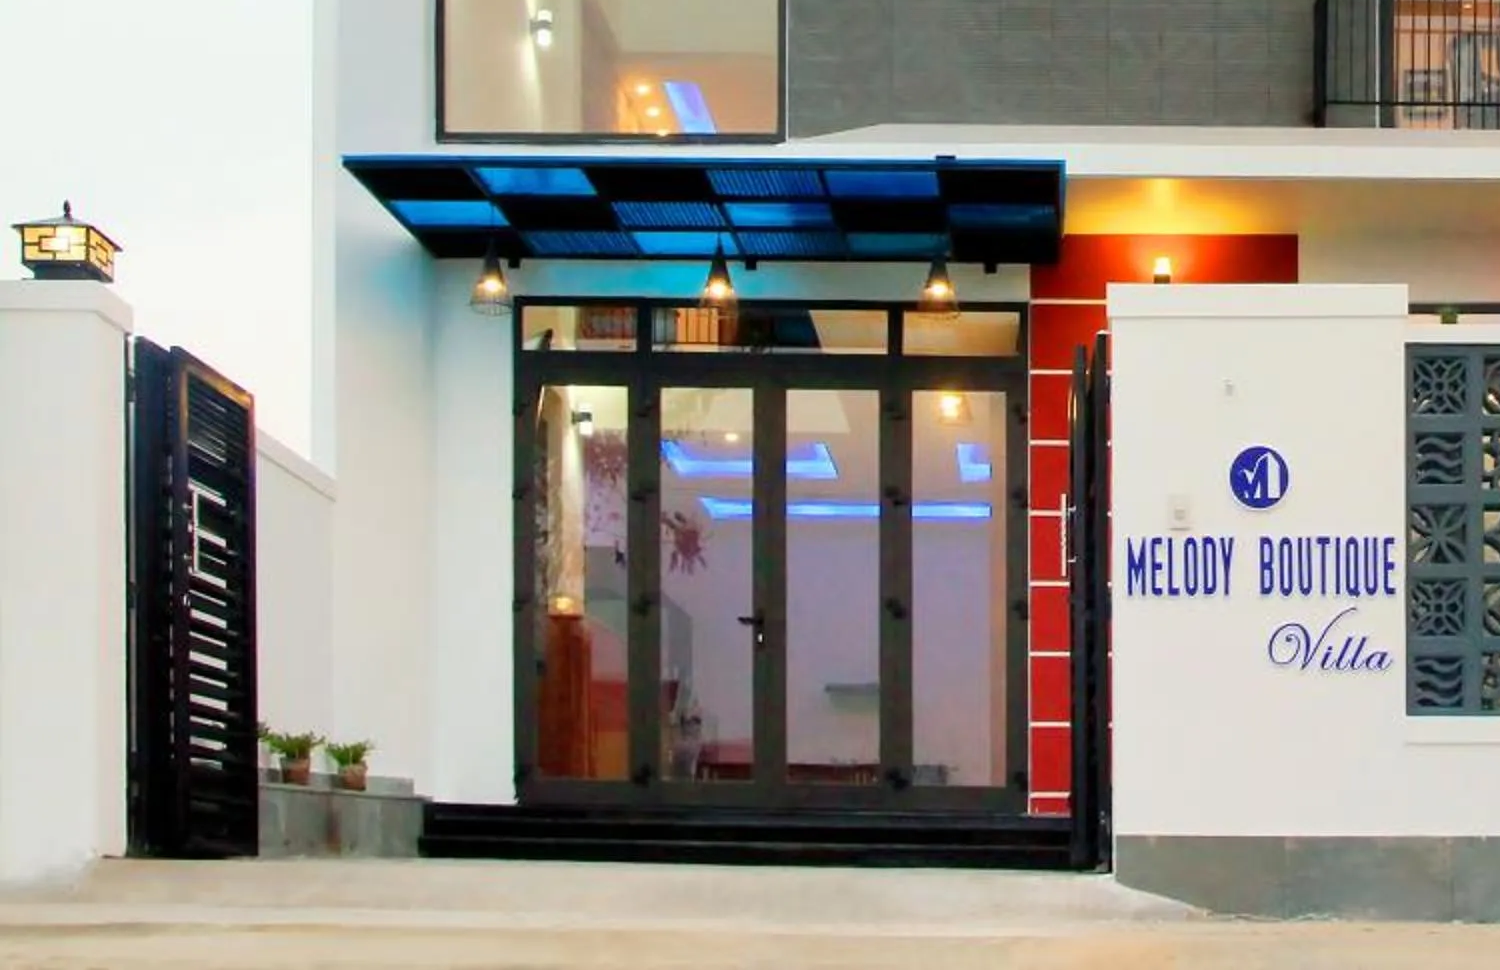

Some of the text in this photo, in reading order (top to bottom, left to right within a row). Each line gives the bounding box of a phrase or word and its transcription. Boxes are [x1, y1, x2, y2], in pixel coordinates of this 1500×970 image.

[1127, 535, 1397, 598] MELODY BOUTIQUE
[1268, 607, 1393, 671] Villa
